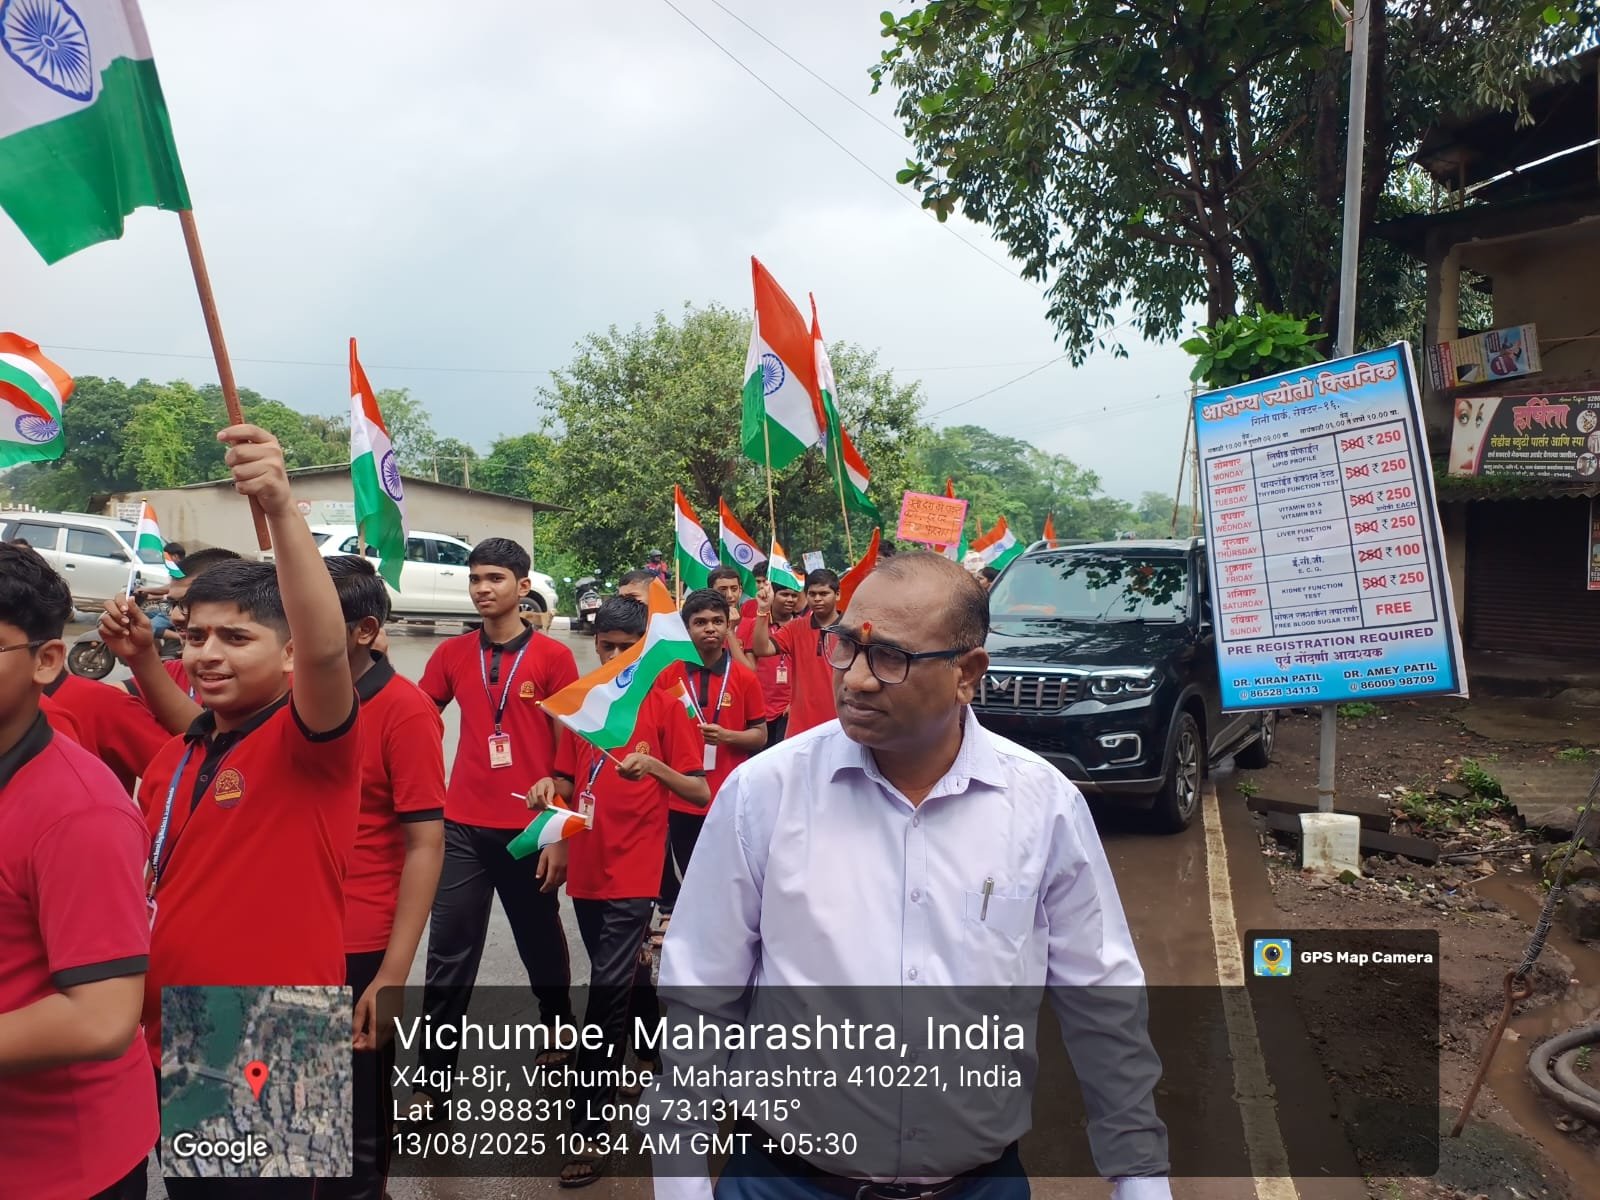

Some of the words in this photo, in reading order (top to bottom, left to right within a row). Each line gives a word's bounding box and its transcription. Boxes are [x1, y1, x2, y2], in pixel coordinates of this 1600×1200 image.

[1202, 394, 1260, 421] आरोग्य
[1263, 375, 1314, 406] ज्योती
[1318, 360, 1397, 394] क्लिनिक
[1375, 430, 1400, 445] 250
[1272, 460, 1288, 468] LIPID
[1290, 455, 1316, 464] PROFILE
[1381, 458, 1405, 473] 250
[1213, 469, 1243, 481] MONDAY
[1258, 488, 1285, 497] THYROID
[1287, 482, 1320, 492] FUNCTION
[1386, 486, 1410, 501] 250
[1215, 495, 1247, 506] TUESDAY
[1395, 501, 1416, 509] EACH
[1278, 504, 1305, 513] VITAMIN
[1281, 511, 1307, 520] VITAMIN
[1390, 514, 1415, 529] 250
[1215, 521, 1251, 532] WEDNDAY
[1277, 530, 1295, 538] LIVER
[1297, 525, 1331, 534] FUNCTION
[1217, 547, 1256, 557] THURSDAY
[1395, 543, 1419, 556] 100
[1226, 574, 1253, 583] FRIDAY
[1399, 571, 1424, 585] 250
[1308, 582, 1342, 591] FUNCTION
[1222, 599, 1263, 610] SATURDAY
[1376, 601, 1412, 615] FREE
[1317, 617, 1340, 625] SUGAR
[1230, 626, 1261, 635] SUNDAY
[1227, 645, 1252, 655] PRE
[1256, 635, 1354, 652] REGISTRATION
[1359, 627, 1433, 643] REQUIRED
[1343, 670, 1362, 678] DR.
[1367, 666, 1399, 676] AMEY
[1403, 662, 1437, 673] PATIL
[1233, 679, 1250, 687] DR.
[1254, 675, 1288, 685] KIRAN
[1292, 673, 1322, 682] PATIL
[1360, 679, 1395, 689] 86009
[1398, 675, 1434, 685] 98709
[1250, 688, 1282, 698] 86528
[1286, 685, 1318, 695] 34113
